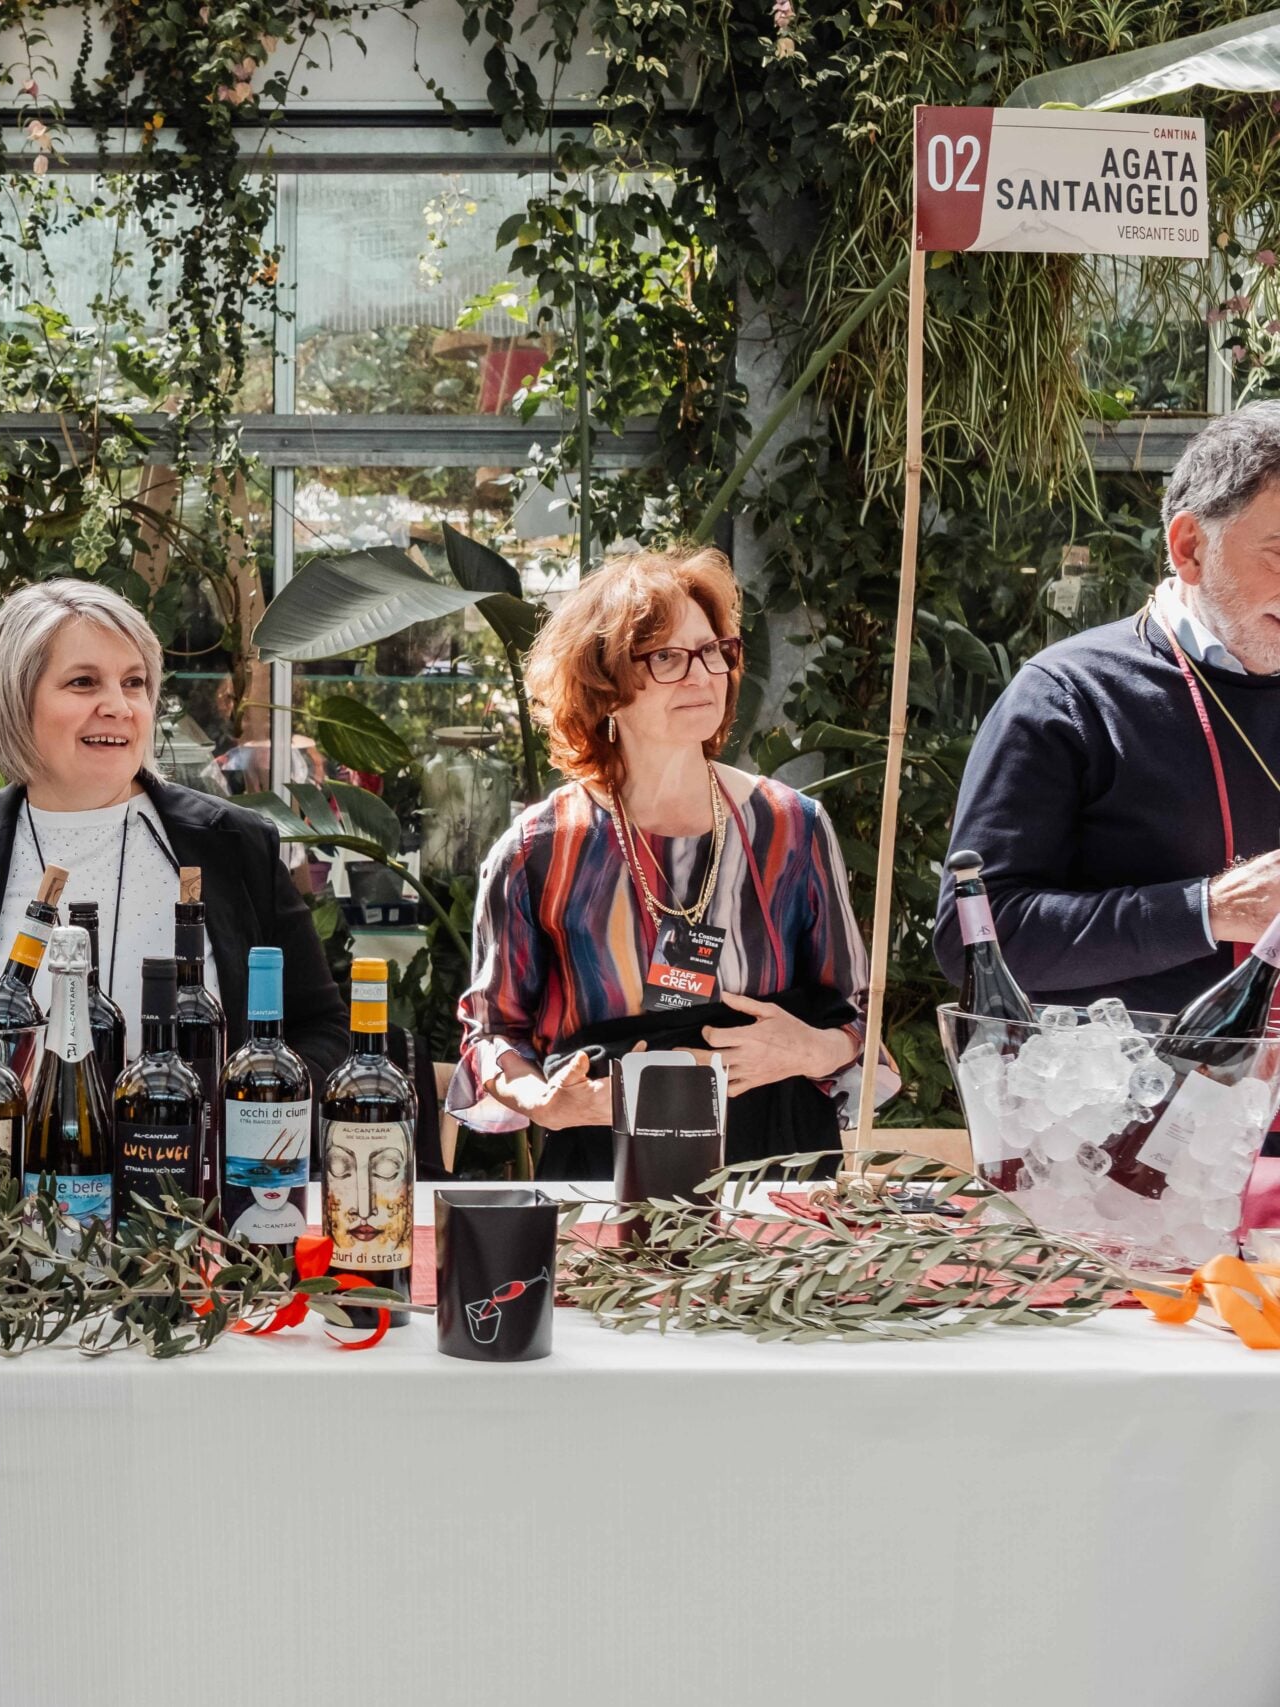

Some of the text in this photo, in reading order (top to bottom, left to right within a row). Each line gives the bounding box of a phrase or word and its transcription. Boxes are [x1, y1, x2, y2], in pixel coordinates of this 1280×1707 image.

[1153, 127, 1198, 141] CANTINA
[927, 134, 982, 192] 02
[1100, 147, 1198, 182] AGATA
[996, 178, 1198, 217] SANTANGELO
[1117, 225, 1200, 242] VERSANTE SUD
[670, 969, 697, 979] STAFF
[660, 975, 702, 992] CREW
[240, 1107, 269, 1118] occhi
[272, 1108, 283, 1118] di
[357, 1252, 367, 1264] di
